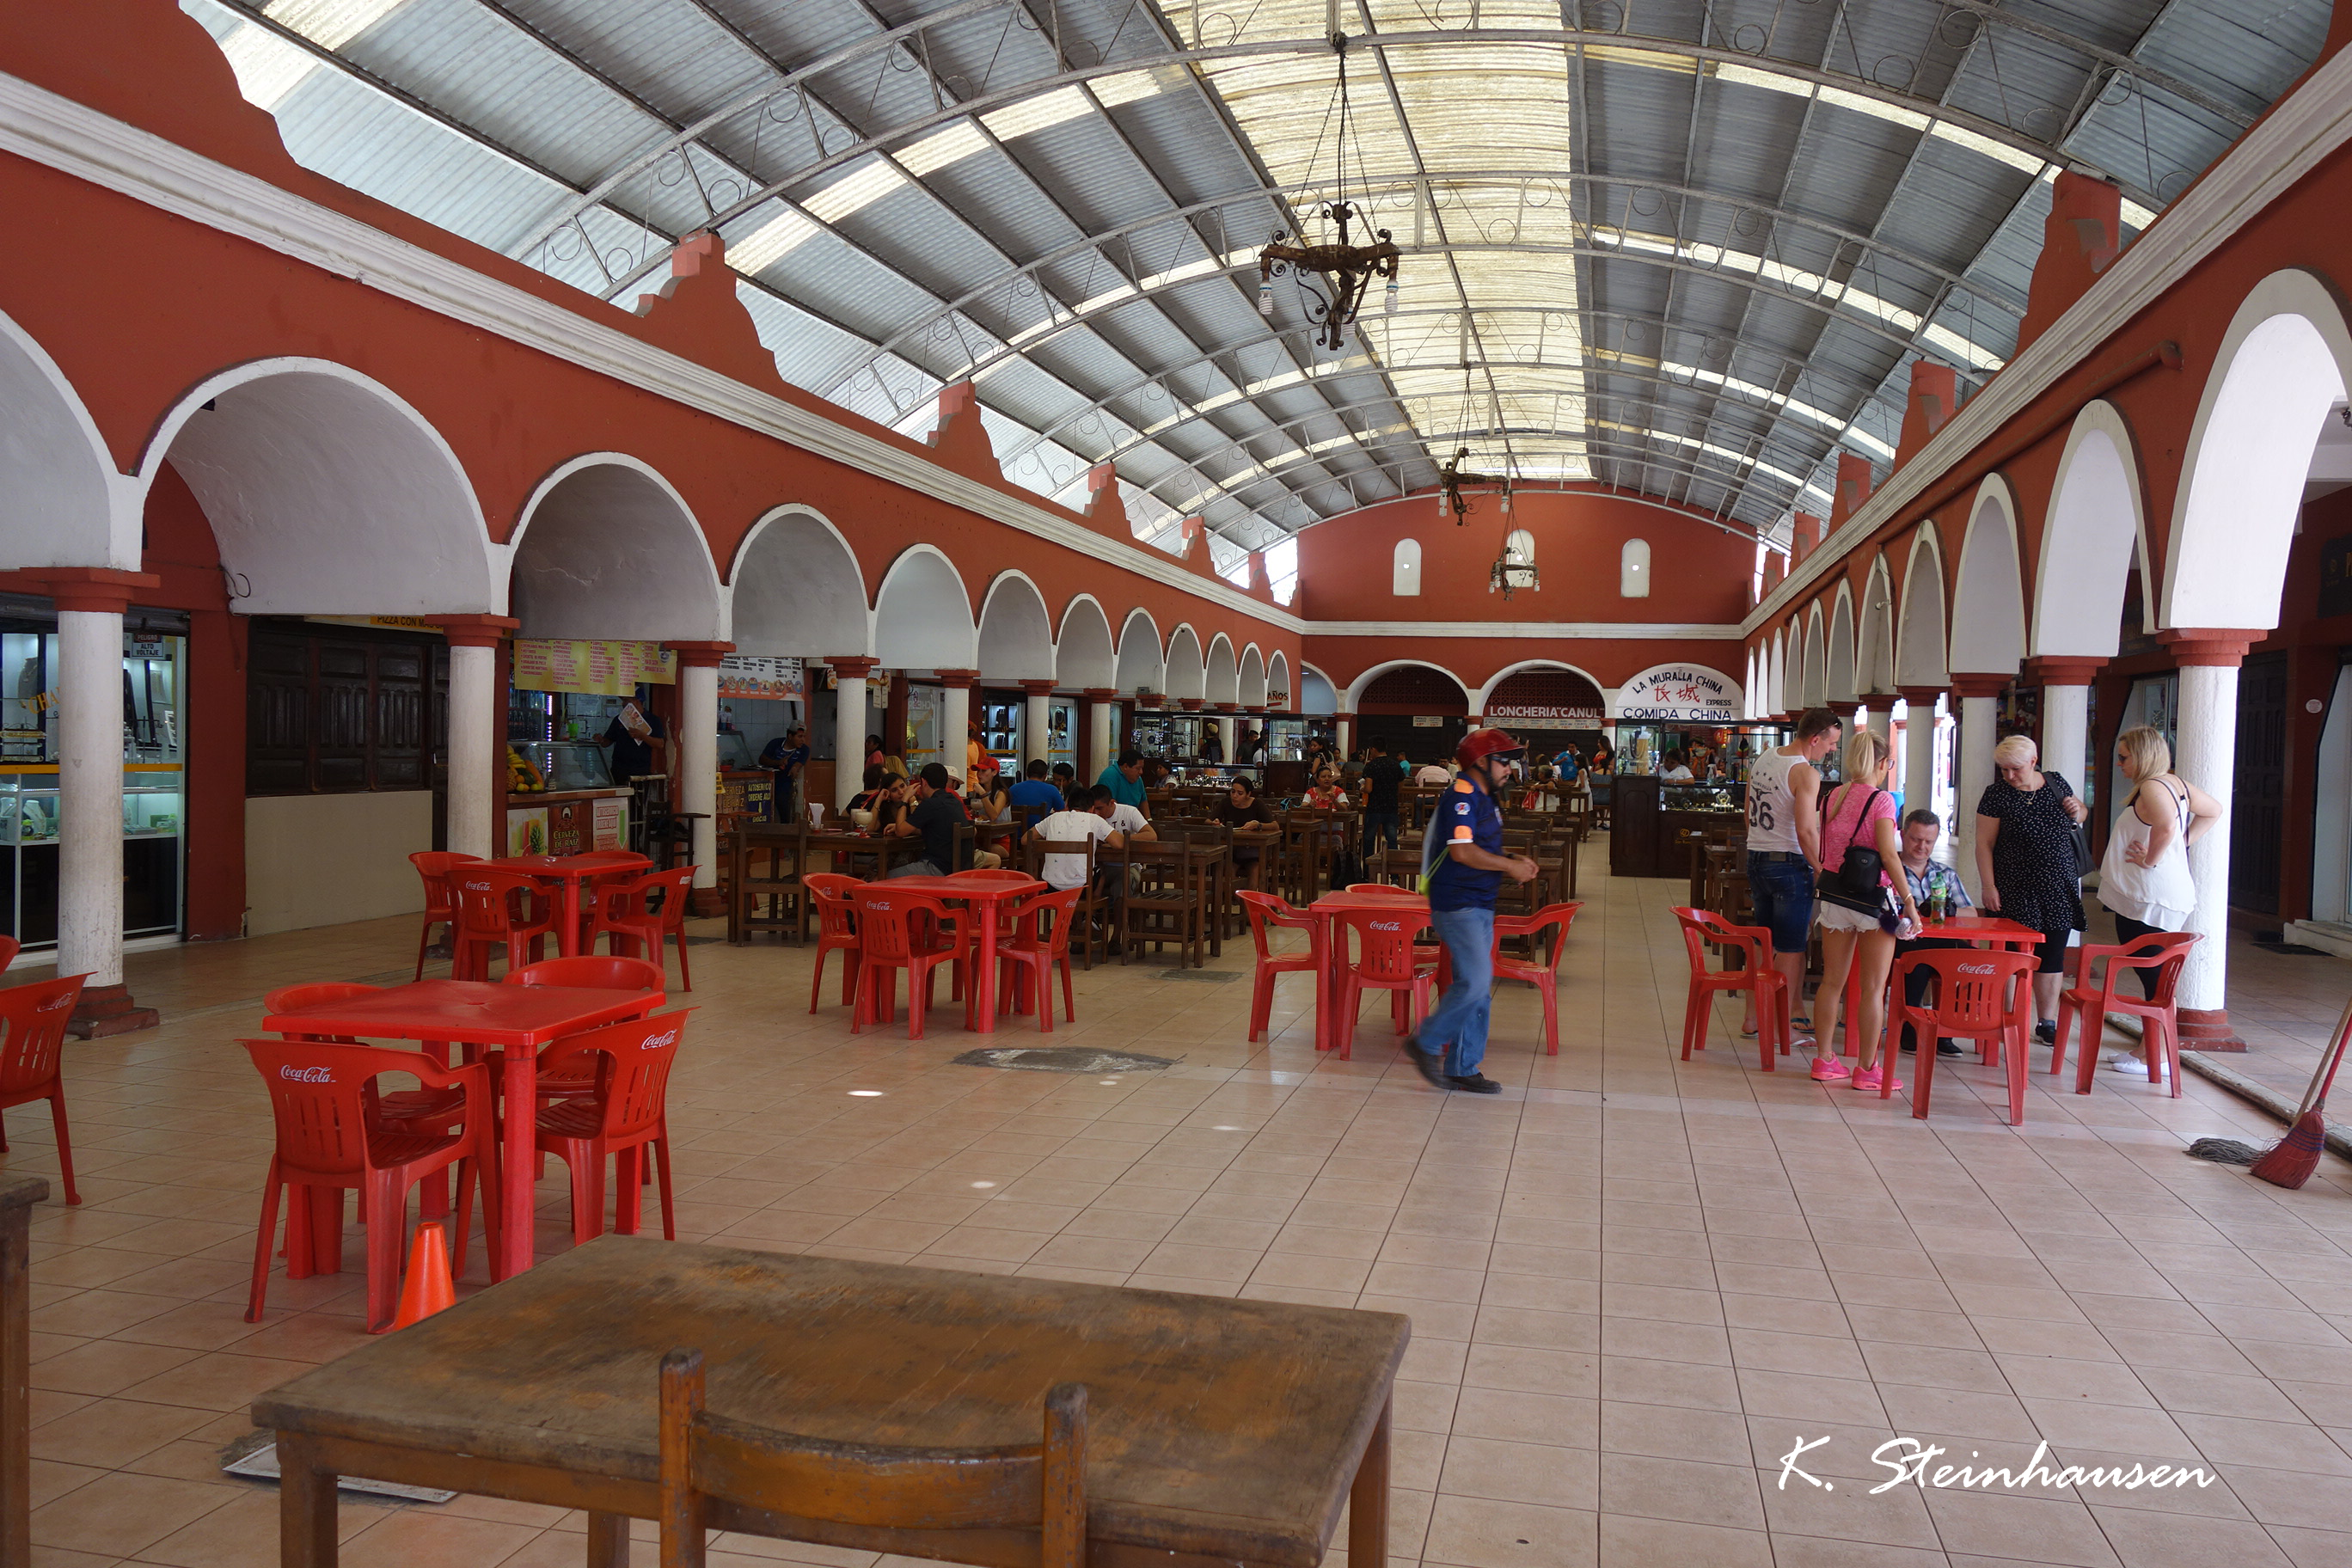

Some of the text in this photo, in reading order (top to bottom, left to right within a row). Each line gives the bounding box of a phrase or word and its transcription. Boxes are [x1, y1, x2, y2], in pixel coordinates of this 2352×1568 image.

[377, 616, 398, 625] PIZZA
[401, 616, 417, 627] CON
[1632, 672, 1723, 695] LA MURALLA CHINA
[1267, 690, 1288, 701] AÑOS
[1490, 706, 1558, 717] LONCHERIA
[1623, 707, 1731, 720] COMIDA CHINA
[553, 830, 579, 840] CERVEZA
